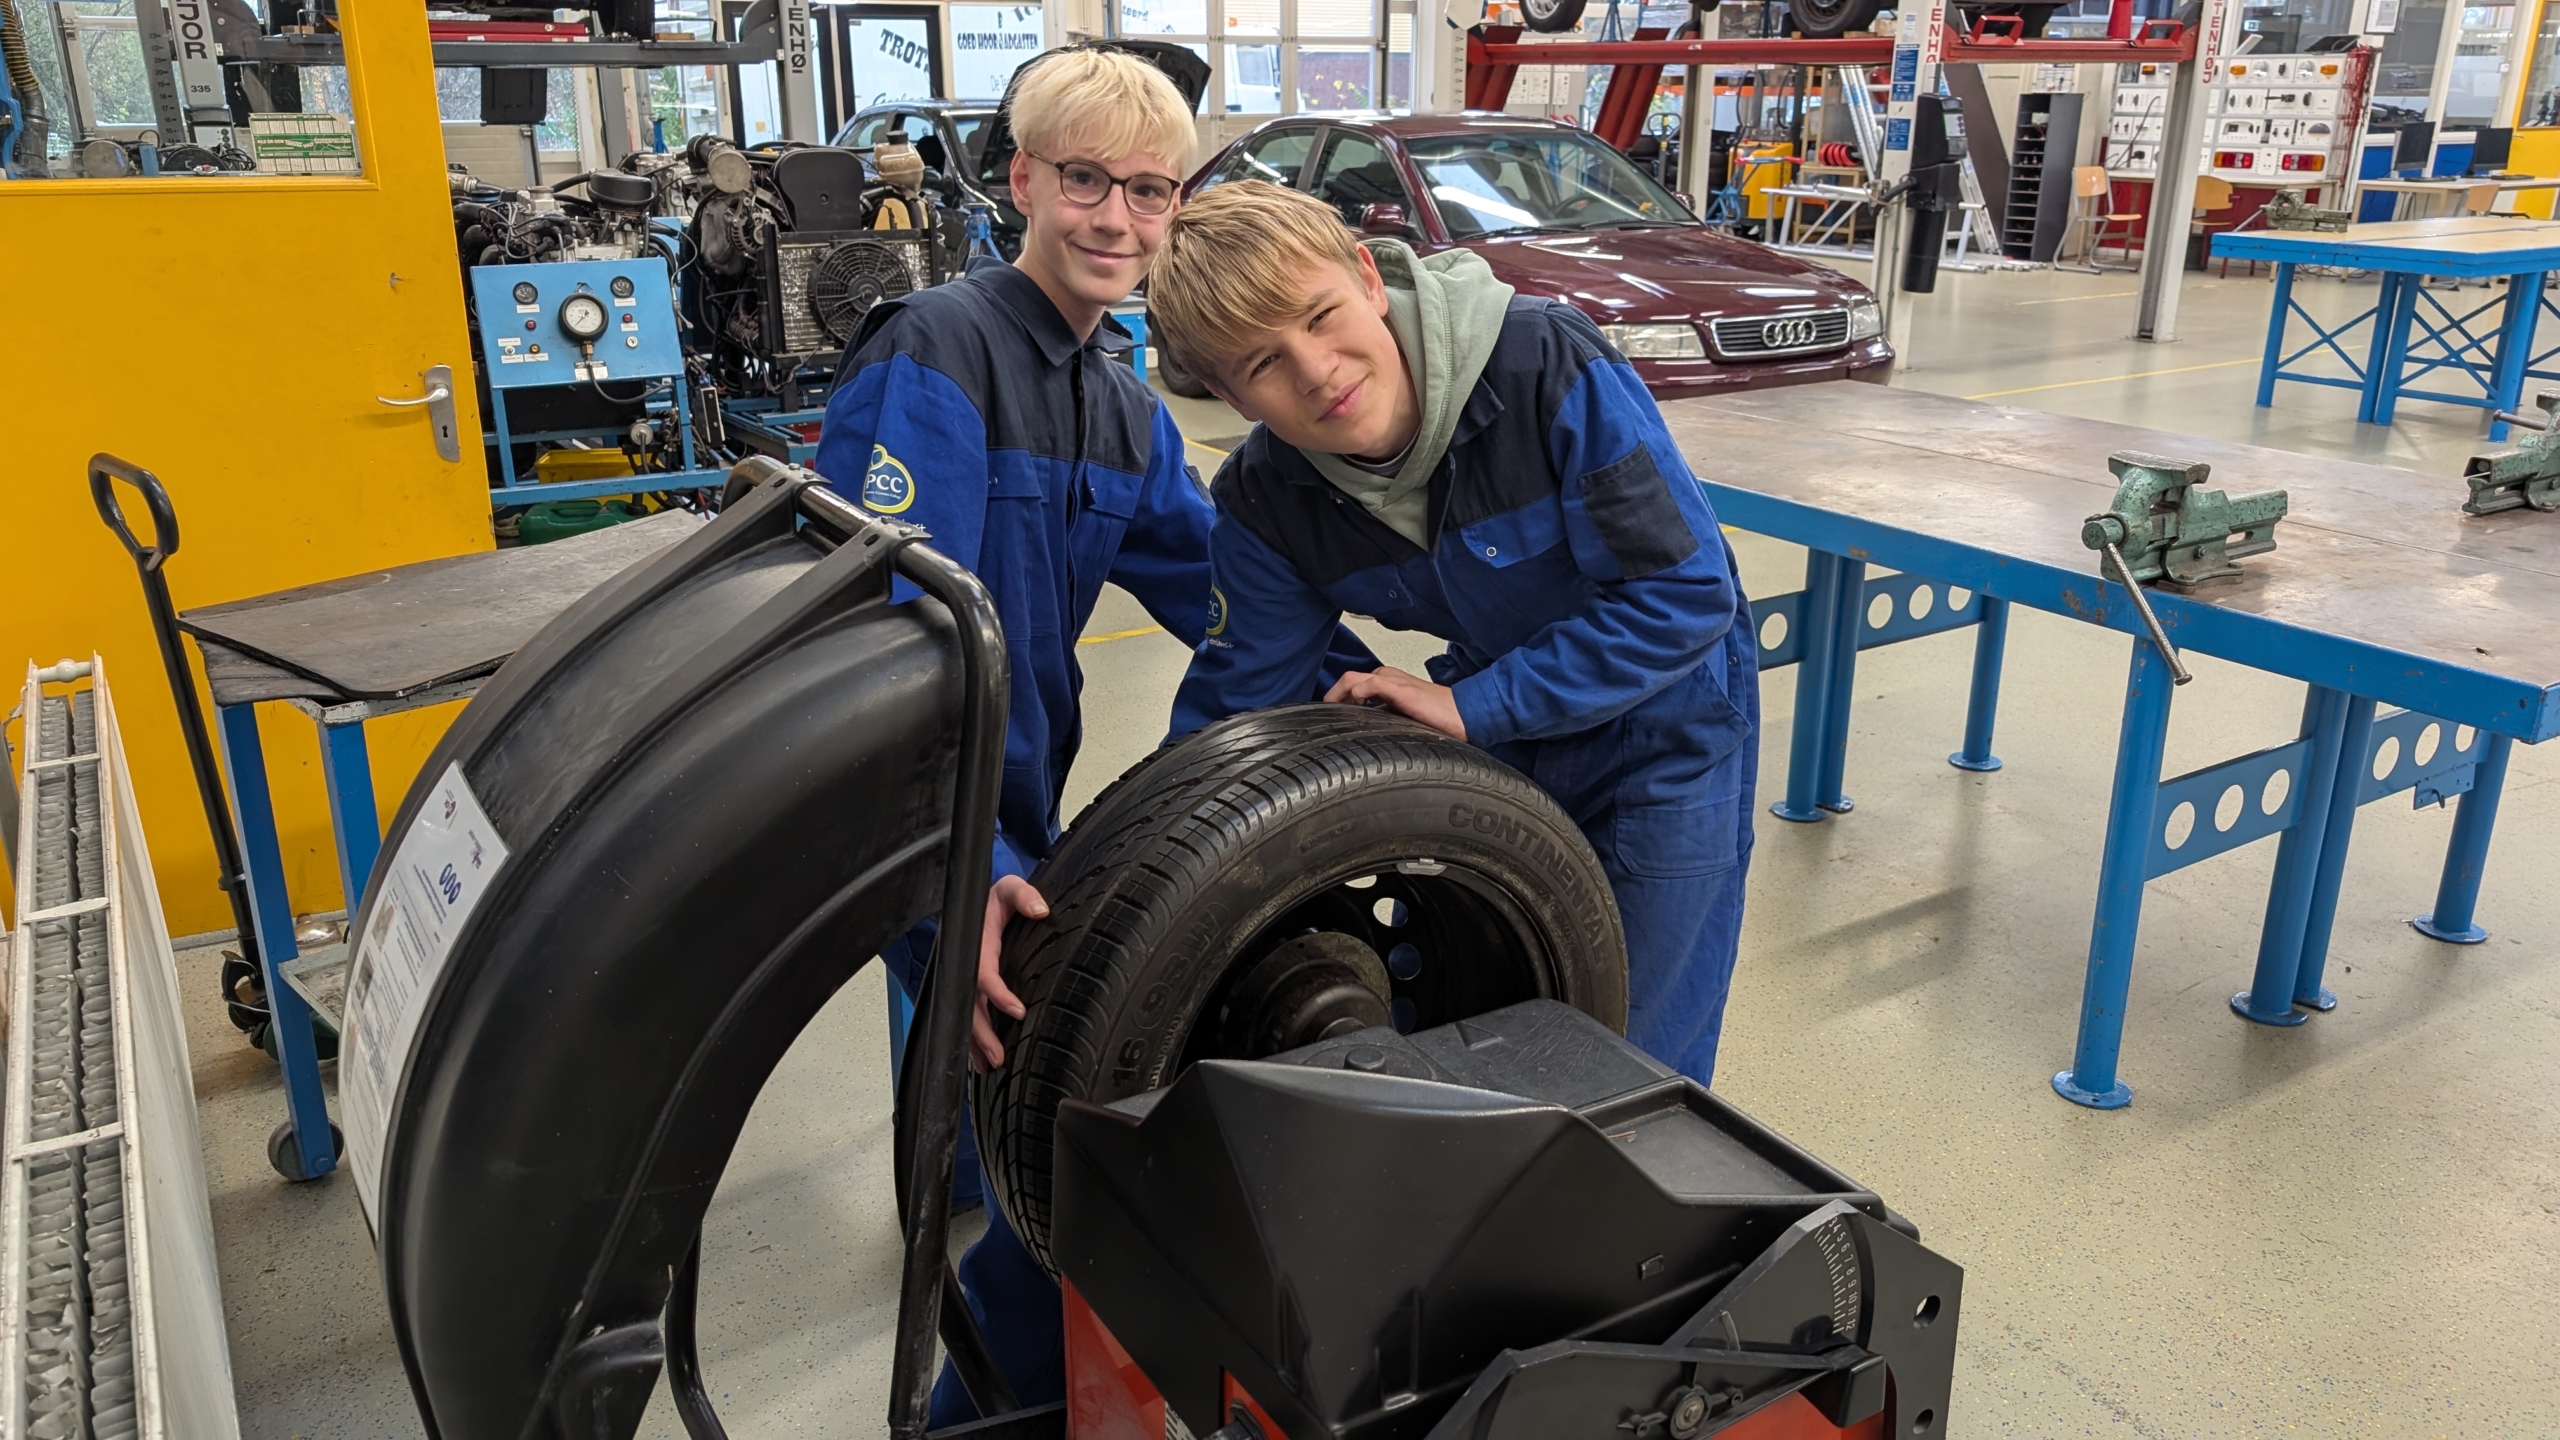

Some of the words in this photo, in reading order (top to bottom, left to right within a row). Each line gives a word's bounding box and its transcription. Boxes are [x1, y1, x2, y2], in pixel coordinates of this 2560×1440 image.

[175, 0, 208, 59] JOR
[2202, 0, 2224, 84] TENHØJ
[190, 85, 211, 93] 335
[866, 474, 903, 493] PCC
[1449, 802, 1610, 965] CONTINENTAL
[1829, 1217, 1838, 1227] 3
[1833, 1224, 1841, 1233] 4
[1837, 1231, 1846, 1242] 5
[1841, 1242, 1850, 1252] 6
[1844, 1253, 1854, 1262] 7
[1846, 1267, 1855, 1275] 8
[1848, 1279, 1857, 1288] 9
[1848, 1291, 1857, 1304] 10
[1848, 1305, 1857, 1316] 11
[1845, 1318, 1856, 1331] 12
